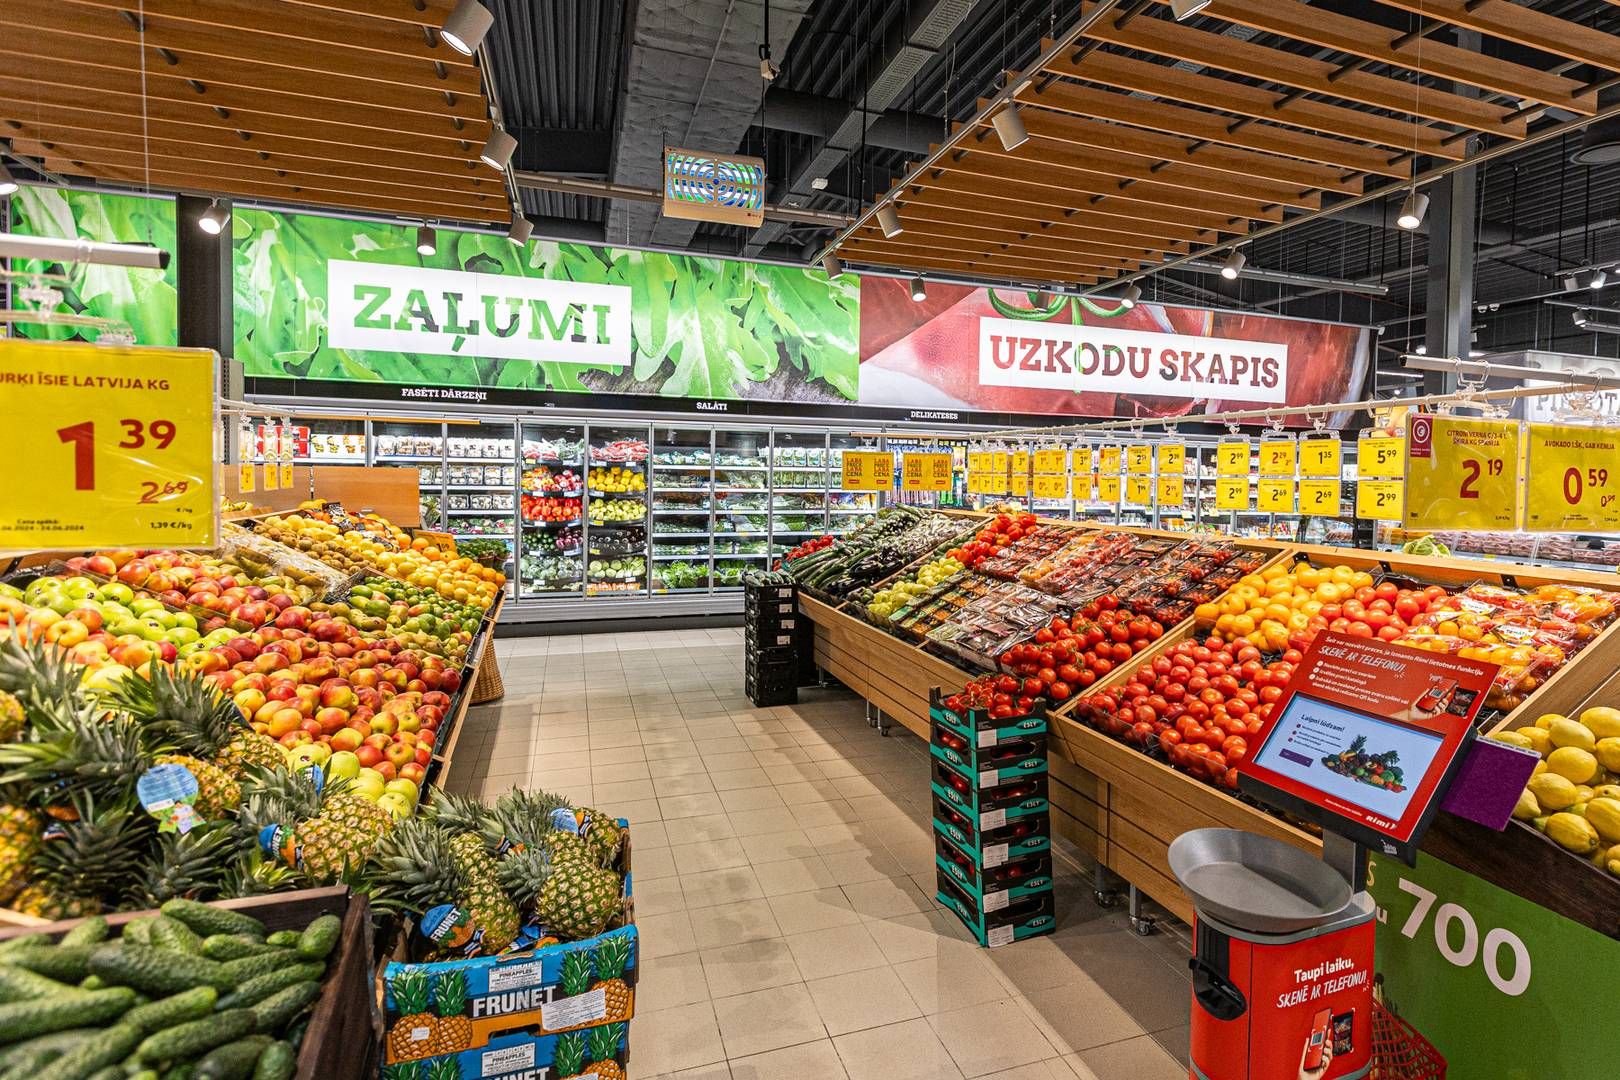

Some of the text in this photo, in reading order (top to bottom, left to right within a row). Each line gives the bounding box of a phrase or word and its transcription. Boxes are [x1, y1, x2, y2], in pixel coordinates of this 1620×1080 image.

[354, 284, 611, 352] ZAĻUMI
[990, 334, 1280, 389] UZKODU SKAPIS
[37, 371, 69, 386] ĪSIE
[73, 376, 144, 390] LATVIJA
[147, 379, 170, 390] KG
[401, 387, 488, 403] FASĒTI DĀRZEŅI
[696, 401, 728, 411] SALĀTI
[910, 411, 959, 421] DELIKATESES
[57, 419, 177, 490] 1 39
[1460, 459, 1504, 499] 2 19
[1563, 467, 1608, 505] 0 59
[1318, 645, 1406, 672] SKENĒ AR TELEFONU!
[1390, 651, 1414, 660] izmanto
[1414, 656, 1429, 664] Rimi
[1429, 658, 1456, 670] lietotnes
[1457, 663, 1484, 676] funkciju
[1300, 714, 1345, 732] Laipni lūdzam!
[430, 908, 462, 942] FRUNET
[1398, 877, 1531, 996] 700
[499, 968, 532, 978] PINEAPPLES
[1294, 957, 1354, 984] Taupi laiku,
[472, 986, 556, 1018] FRUNET
[1276, 969, 1367, 1008] SKENĒ AR TELEFONU!
[492, 1052, 526, 1062] PINEAPPLES
